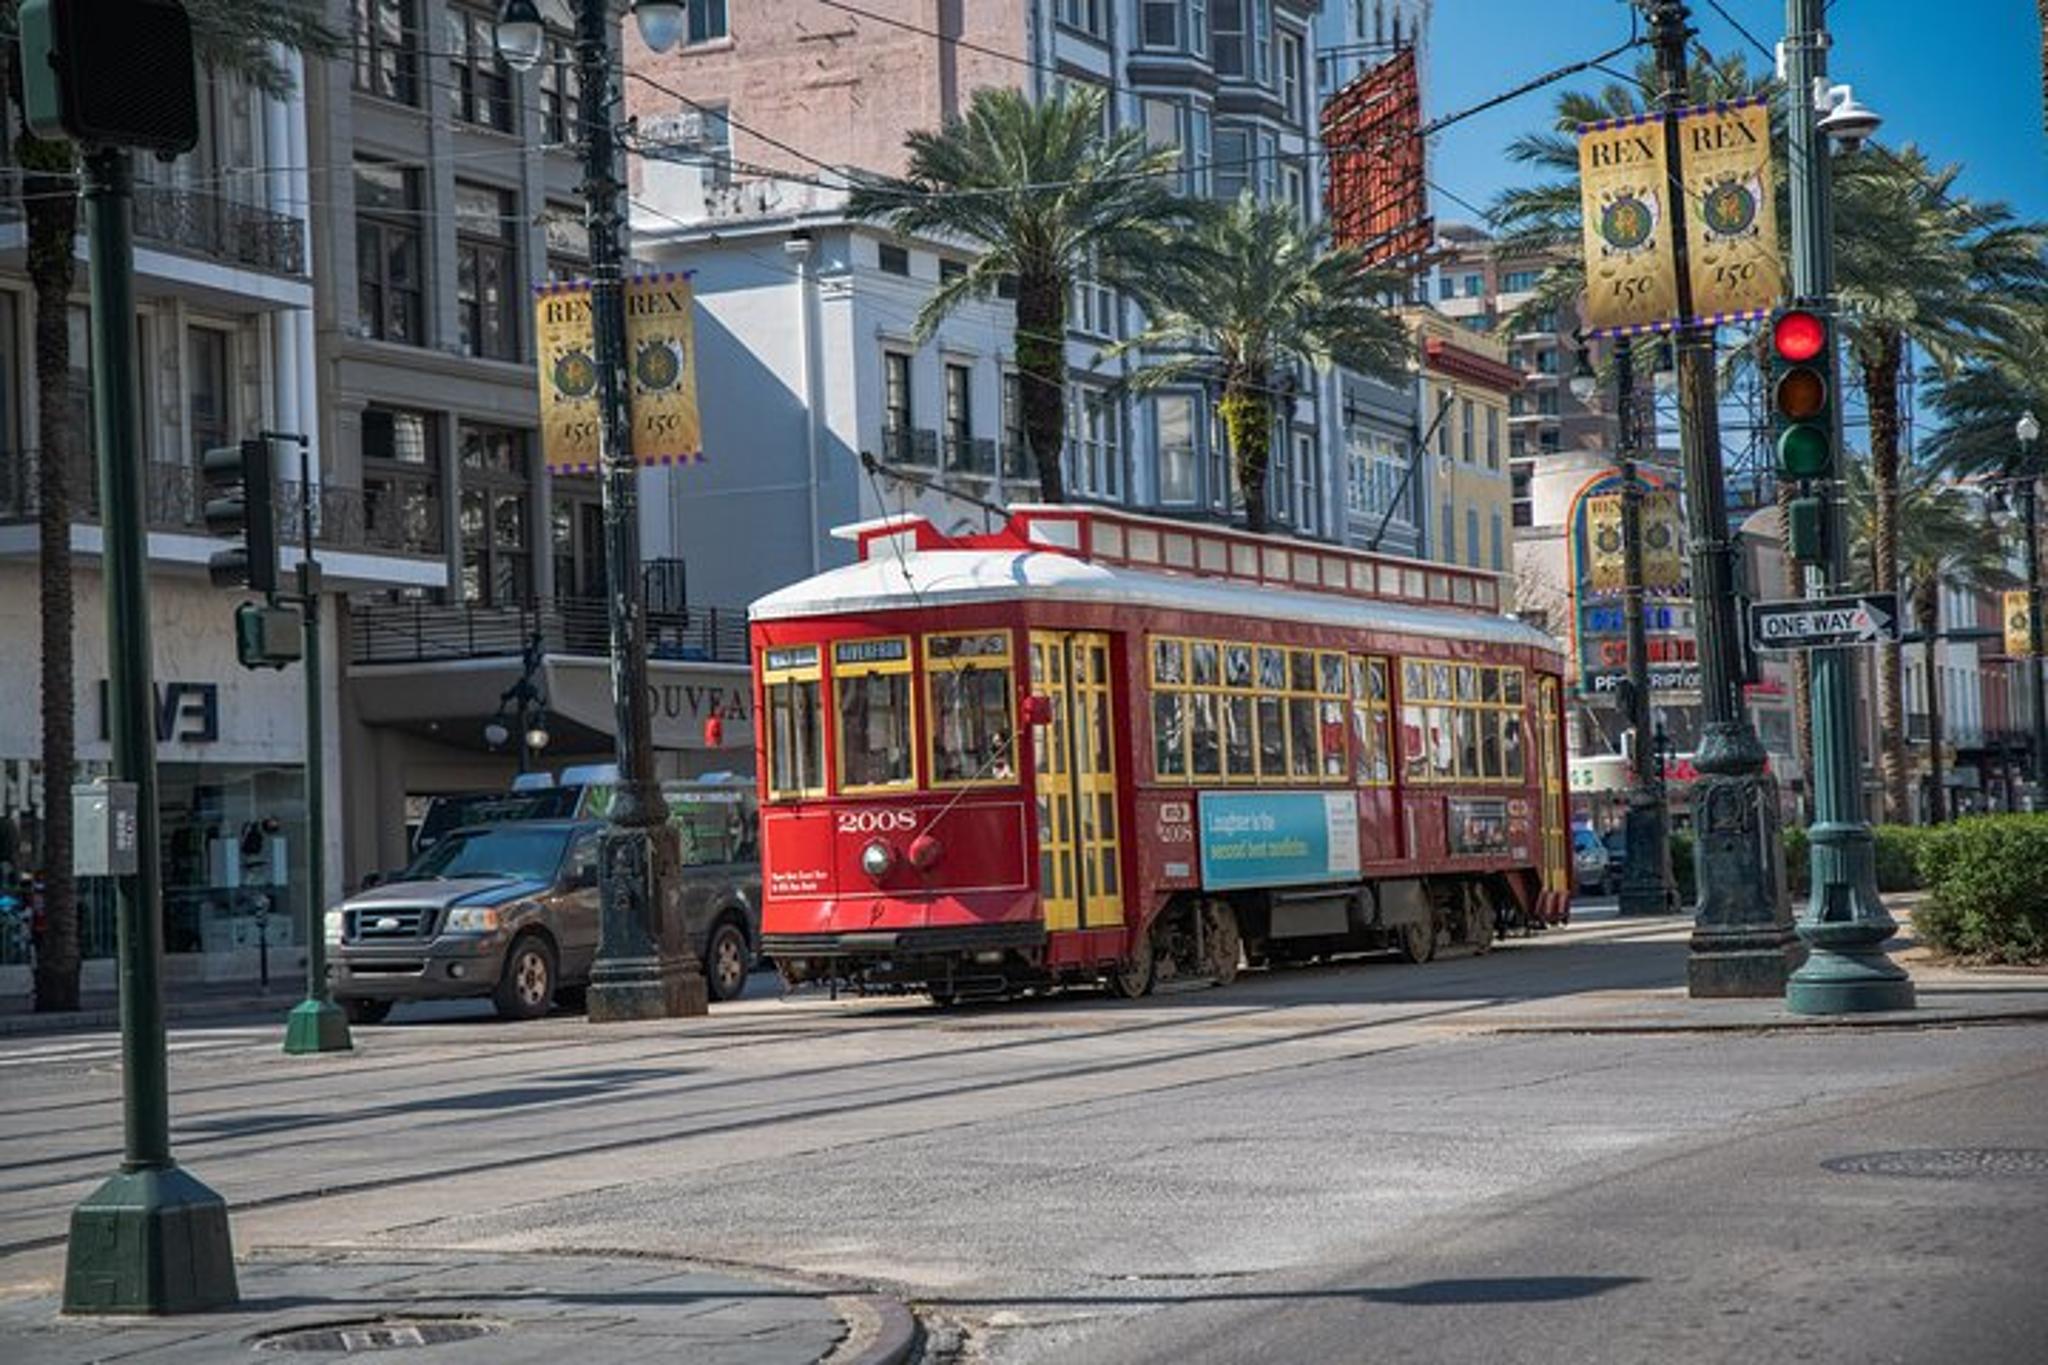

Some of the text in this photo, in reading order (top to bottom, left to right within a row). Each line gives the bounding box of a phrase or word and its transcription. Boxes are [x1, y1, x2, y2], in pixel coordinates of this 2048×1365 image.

[1692, 121, 1757, 152] REX
[1592, 138, 1655, 168] REX
[1613, 274, 1654, 301] 150
[1716, 261, 1756, 288] 150
[628, 290, 683, 317] REX
[646, 414, 681, 438] 150
[1766, 610, 1855, 636] ONE WAY
[838, 810, 917, 833] 2008
